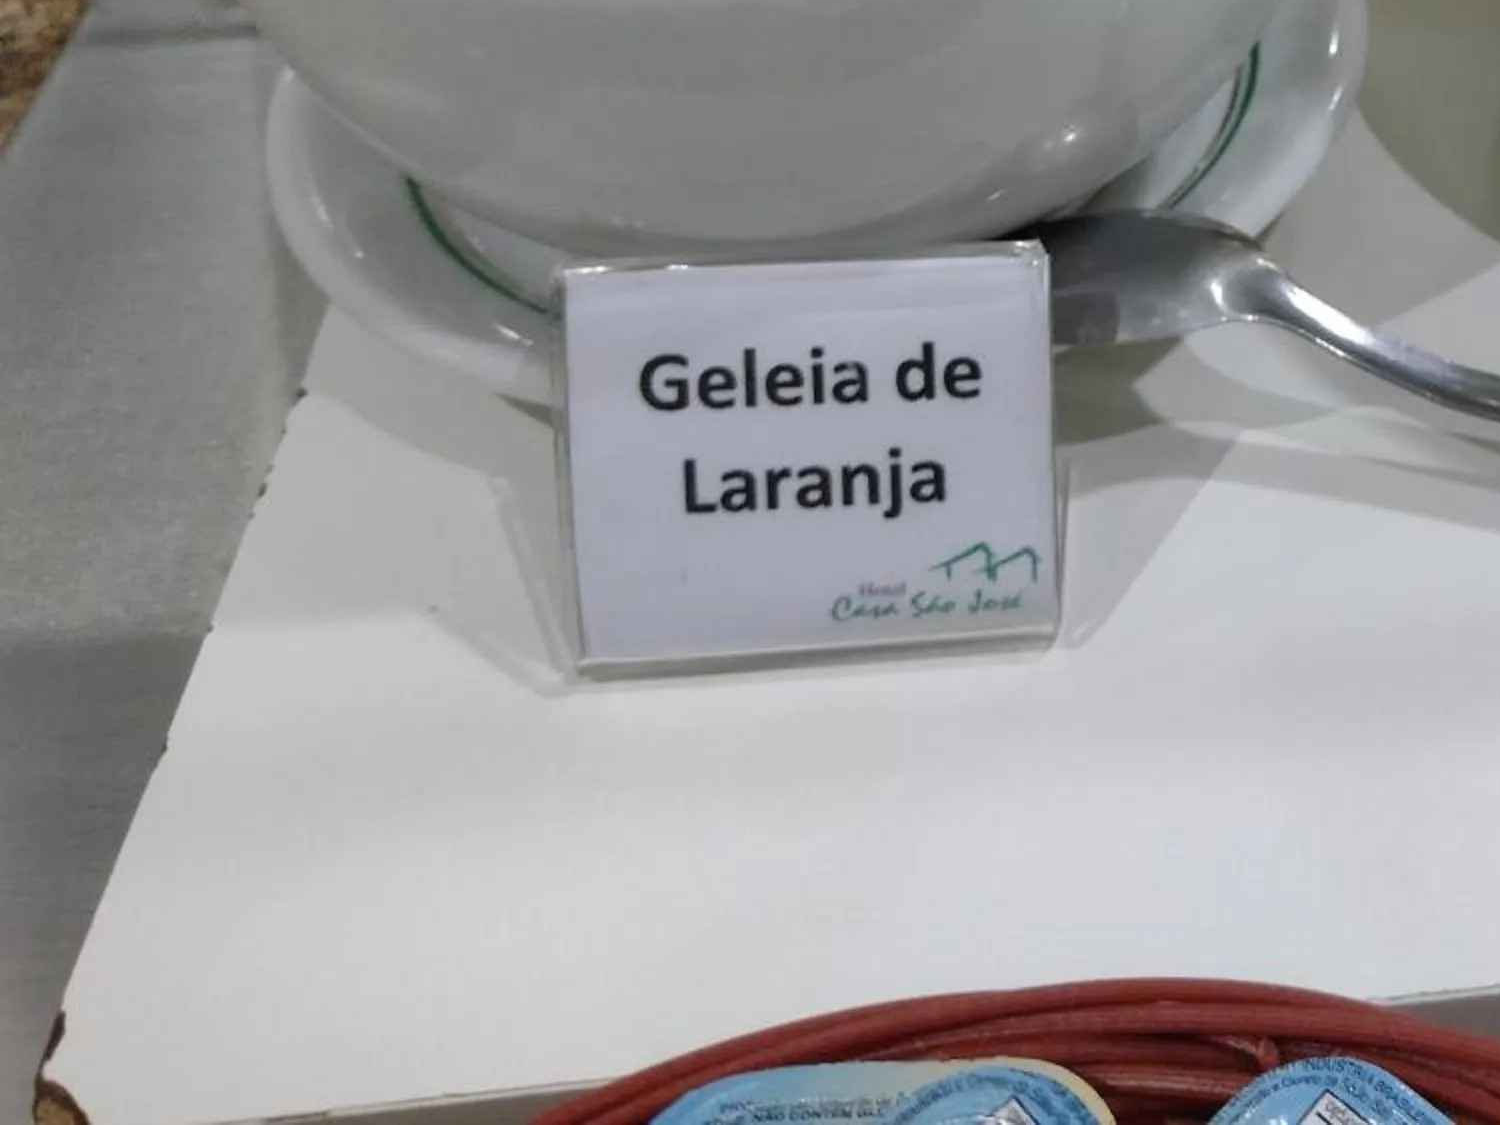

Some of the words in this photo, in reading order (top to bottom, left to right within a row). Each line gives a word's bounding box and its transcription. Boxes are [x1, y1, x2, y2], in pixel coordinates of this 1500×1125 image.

[638, 346, 869, 412] Geleia
[895, 341, 983, 401] de
[683, 446, 947, 519] Laranja
